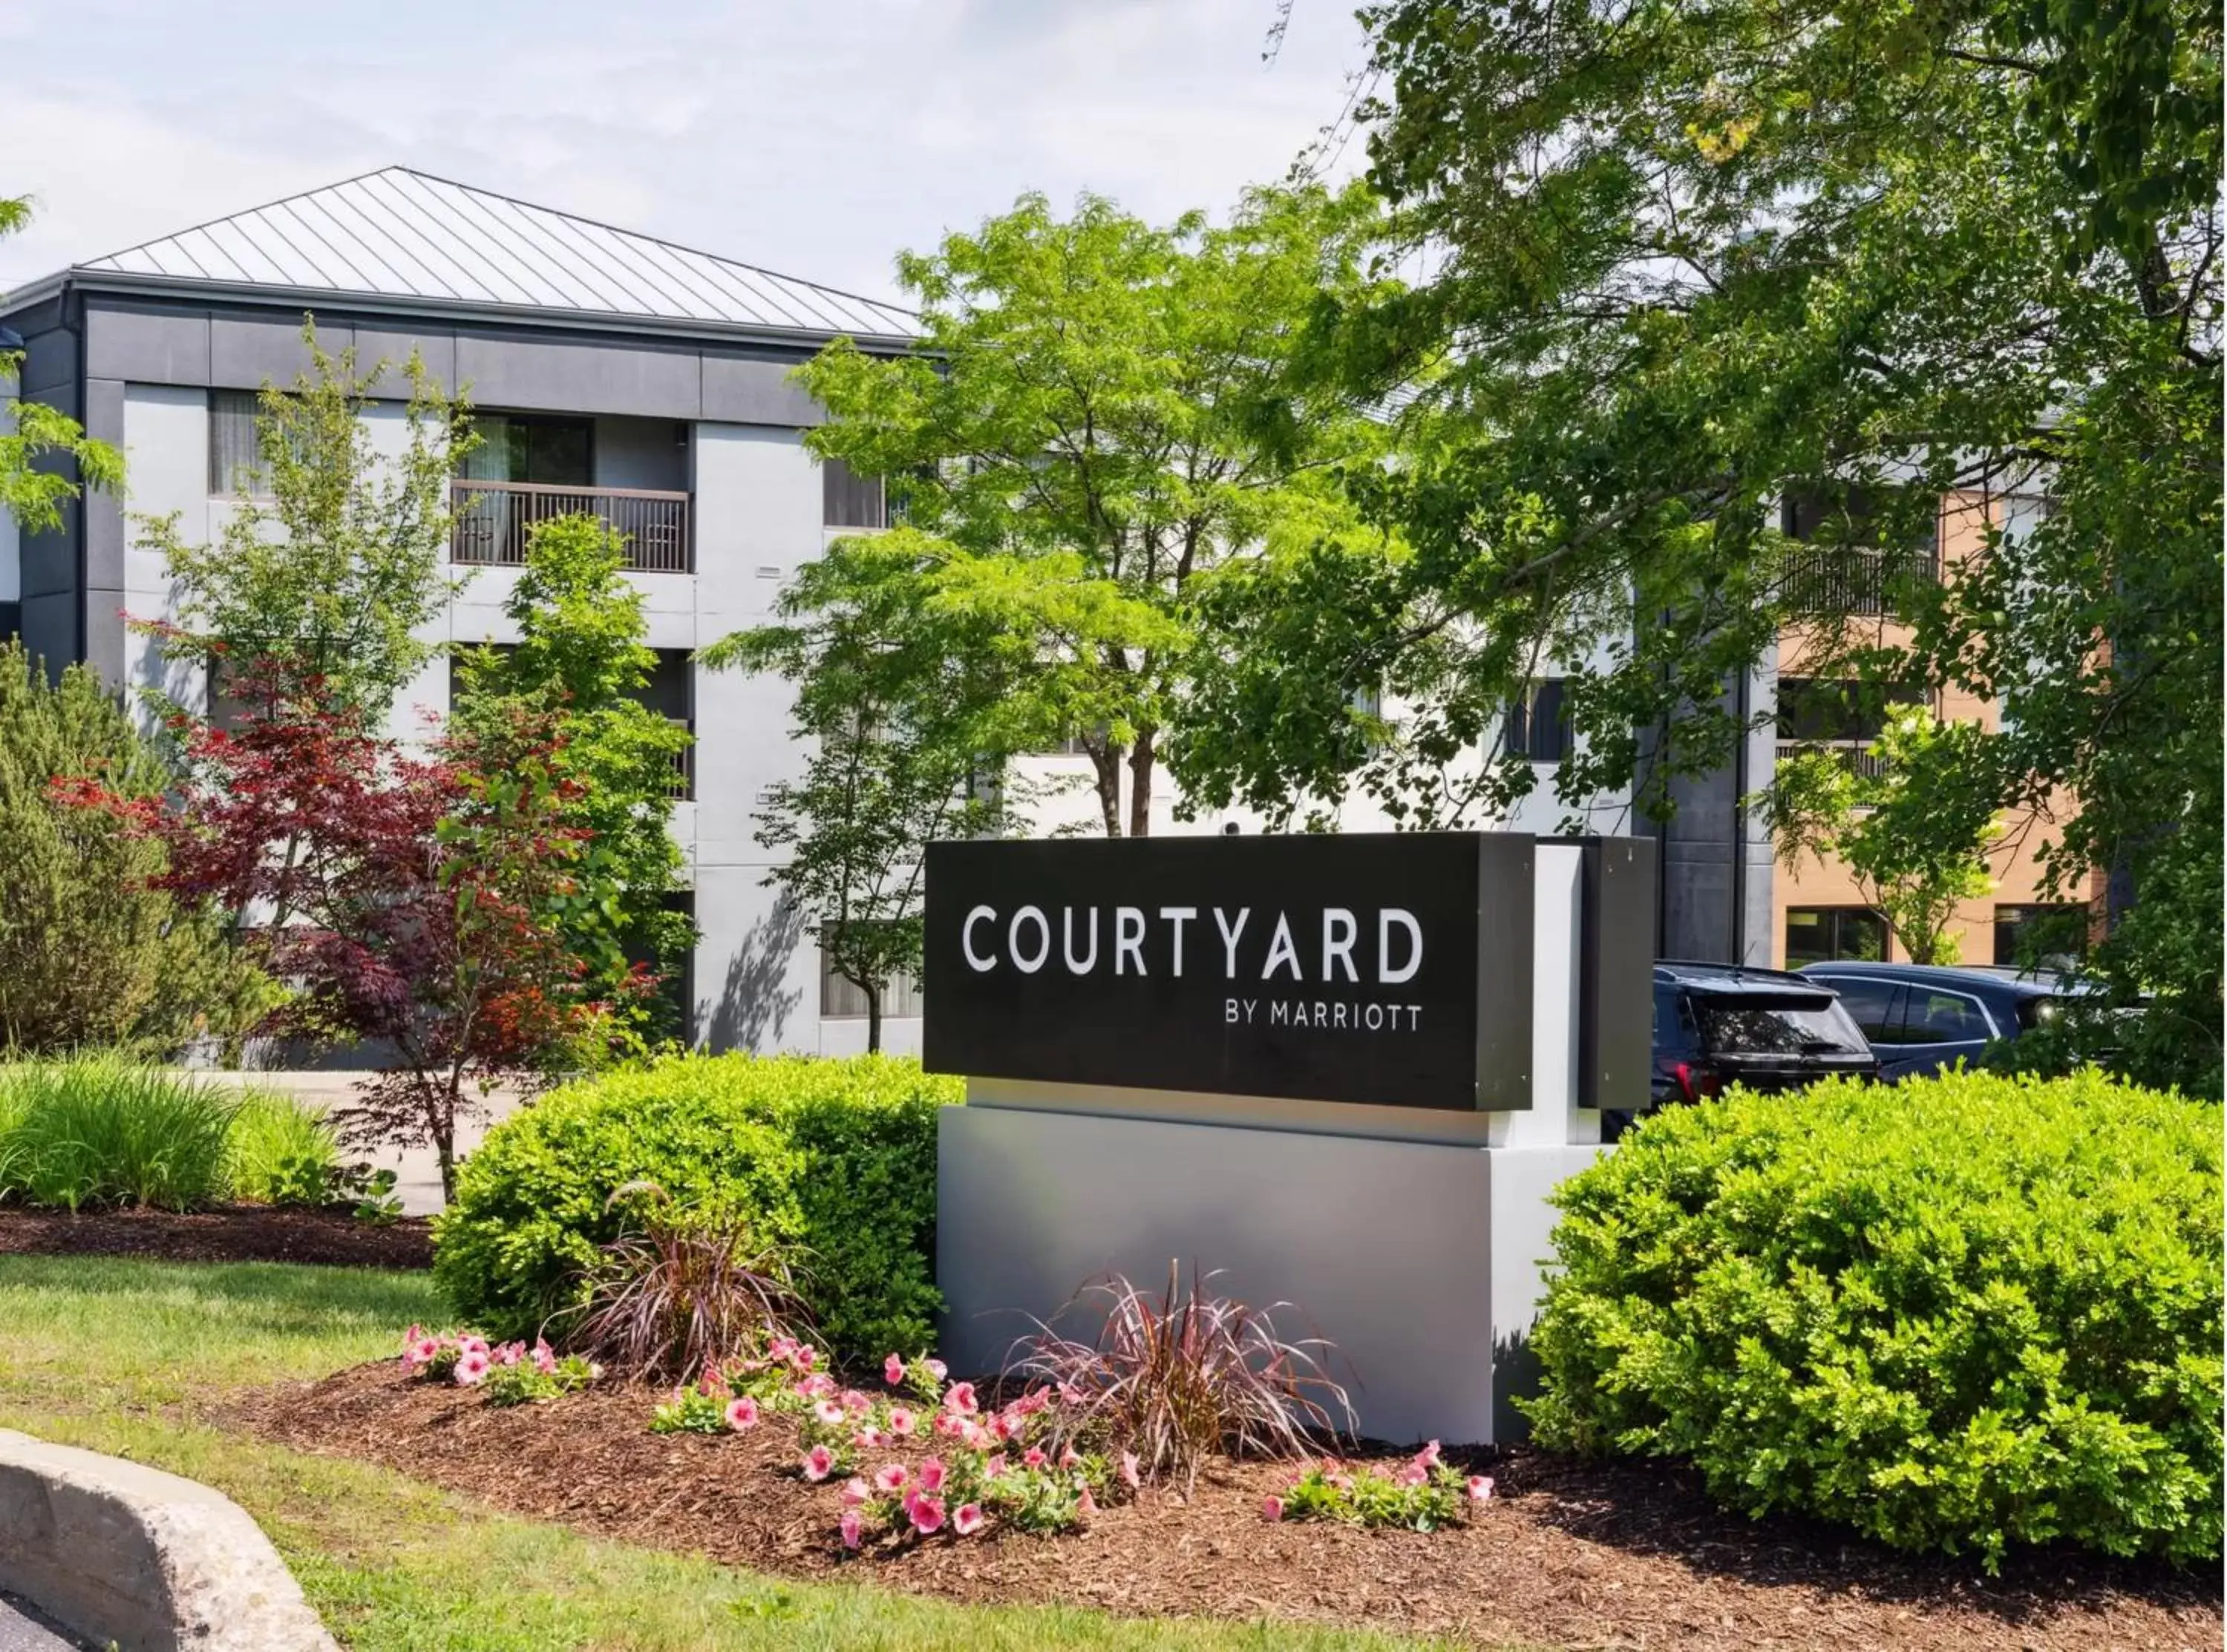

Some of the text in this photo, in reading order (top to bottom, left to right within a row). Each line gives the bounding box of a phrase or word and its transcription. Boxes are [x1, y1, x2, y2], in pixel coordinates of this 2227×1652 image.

[962, 904, 1424, 984] COURTYARD
[1225, 997, 1422, 1032] BY MARRIOTT
